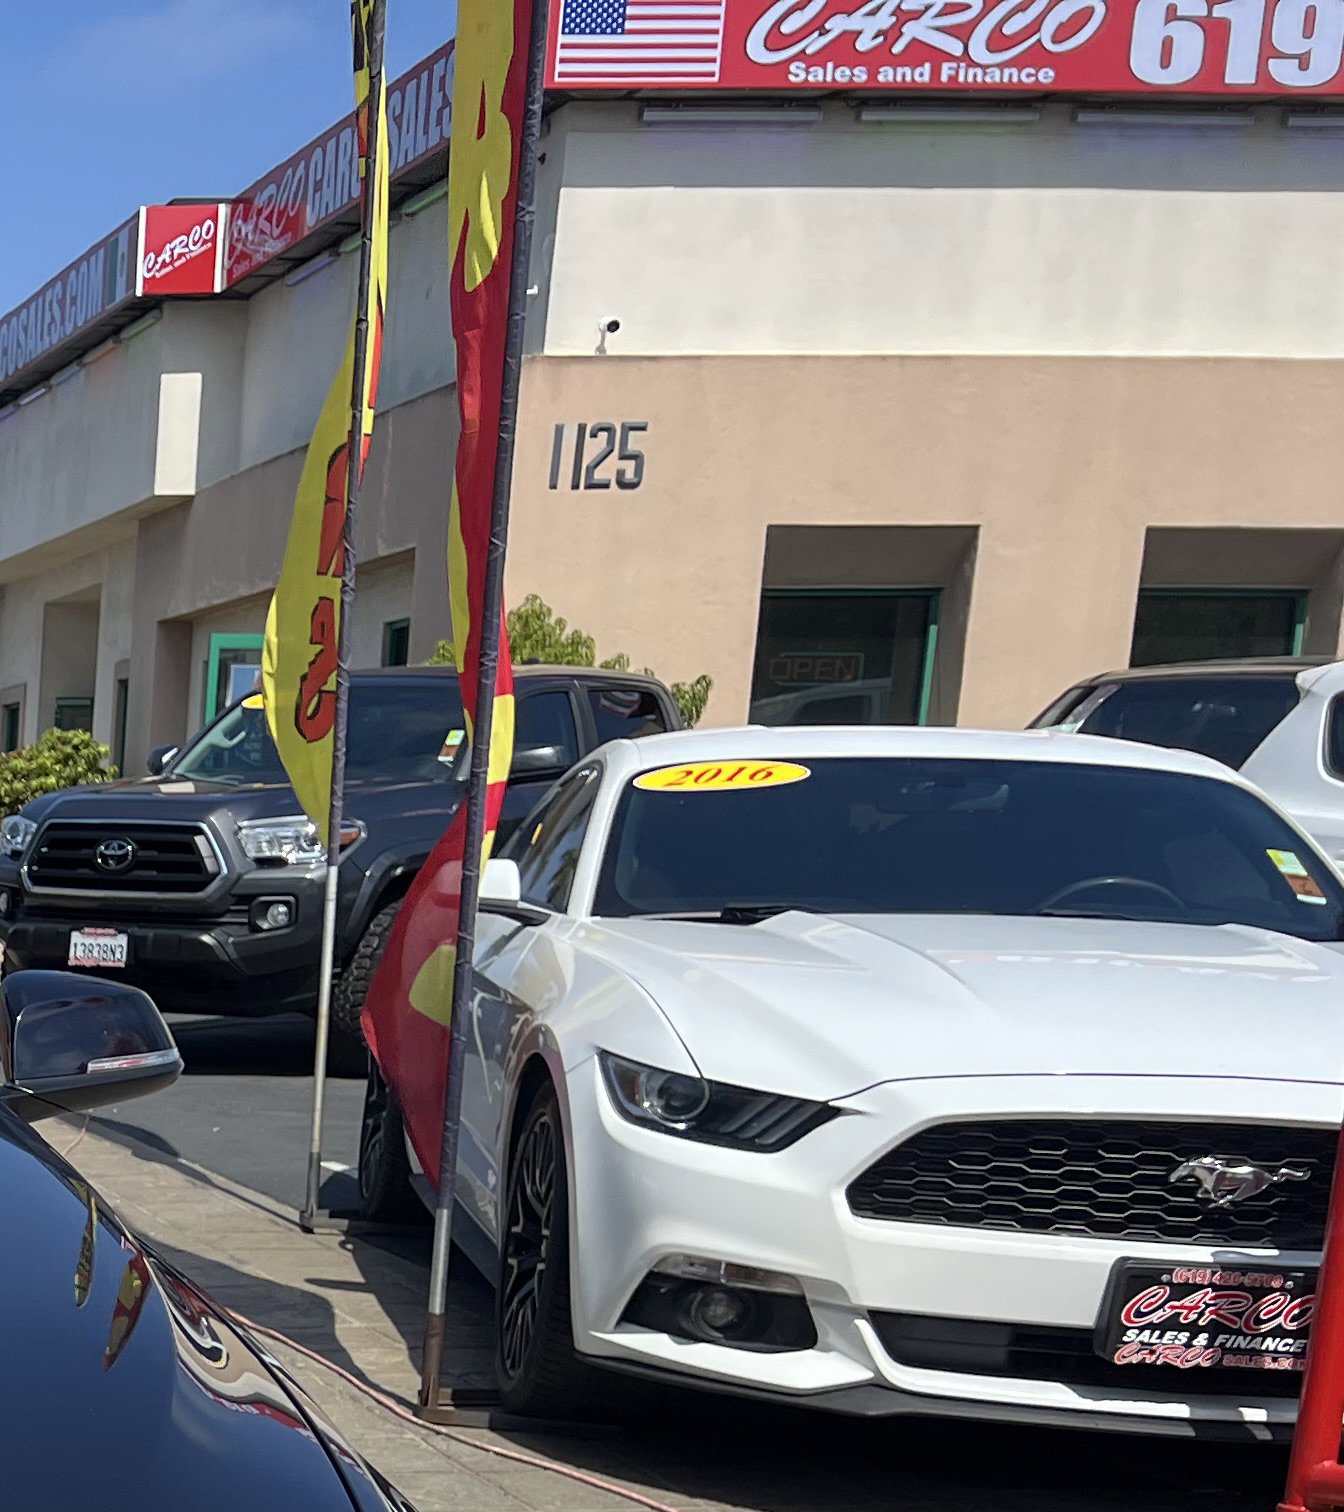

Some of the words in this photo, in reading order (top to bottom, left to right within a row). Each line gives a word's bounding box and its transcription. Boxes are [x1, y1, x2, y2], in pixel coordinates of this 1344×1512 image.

[1129, 0, 1344, 86] 619
[787, 61, 868, 83] Sales
[877, 62, 930, 83] and
[941, 61, 1055, 83] Finance
[143, 219, 215, 279] CARCO
[548, 421, 649, 490] 1125
[770, 657, 856, 681] OPEN
[662, 765, 779, 788] 2016
[1121, 1285, 1315, 1334] CARCO
[1122, 1328, 1191, 1345] SALES
[1192, 1332, 1210, 1347] &
[1214, 1334, 1308, 1352] FINANCE
[1114, 1342, 1222, 1369] CARCO
